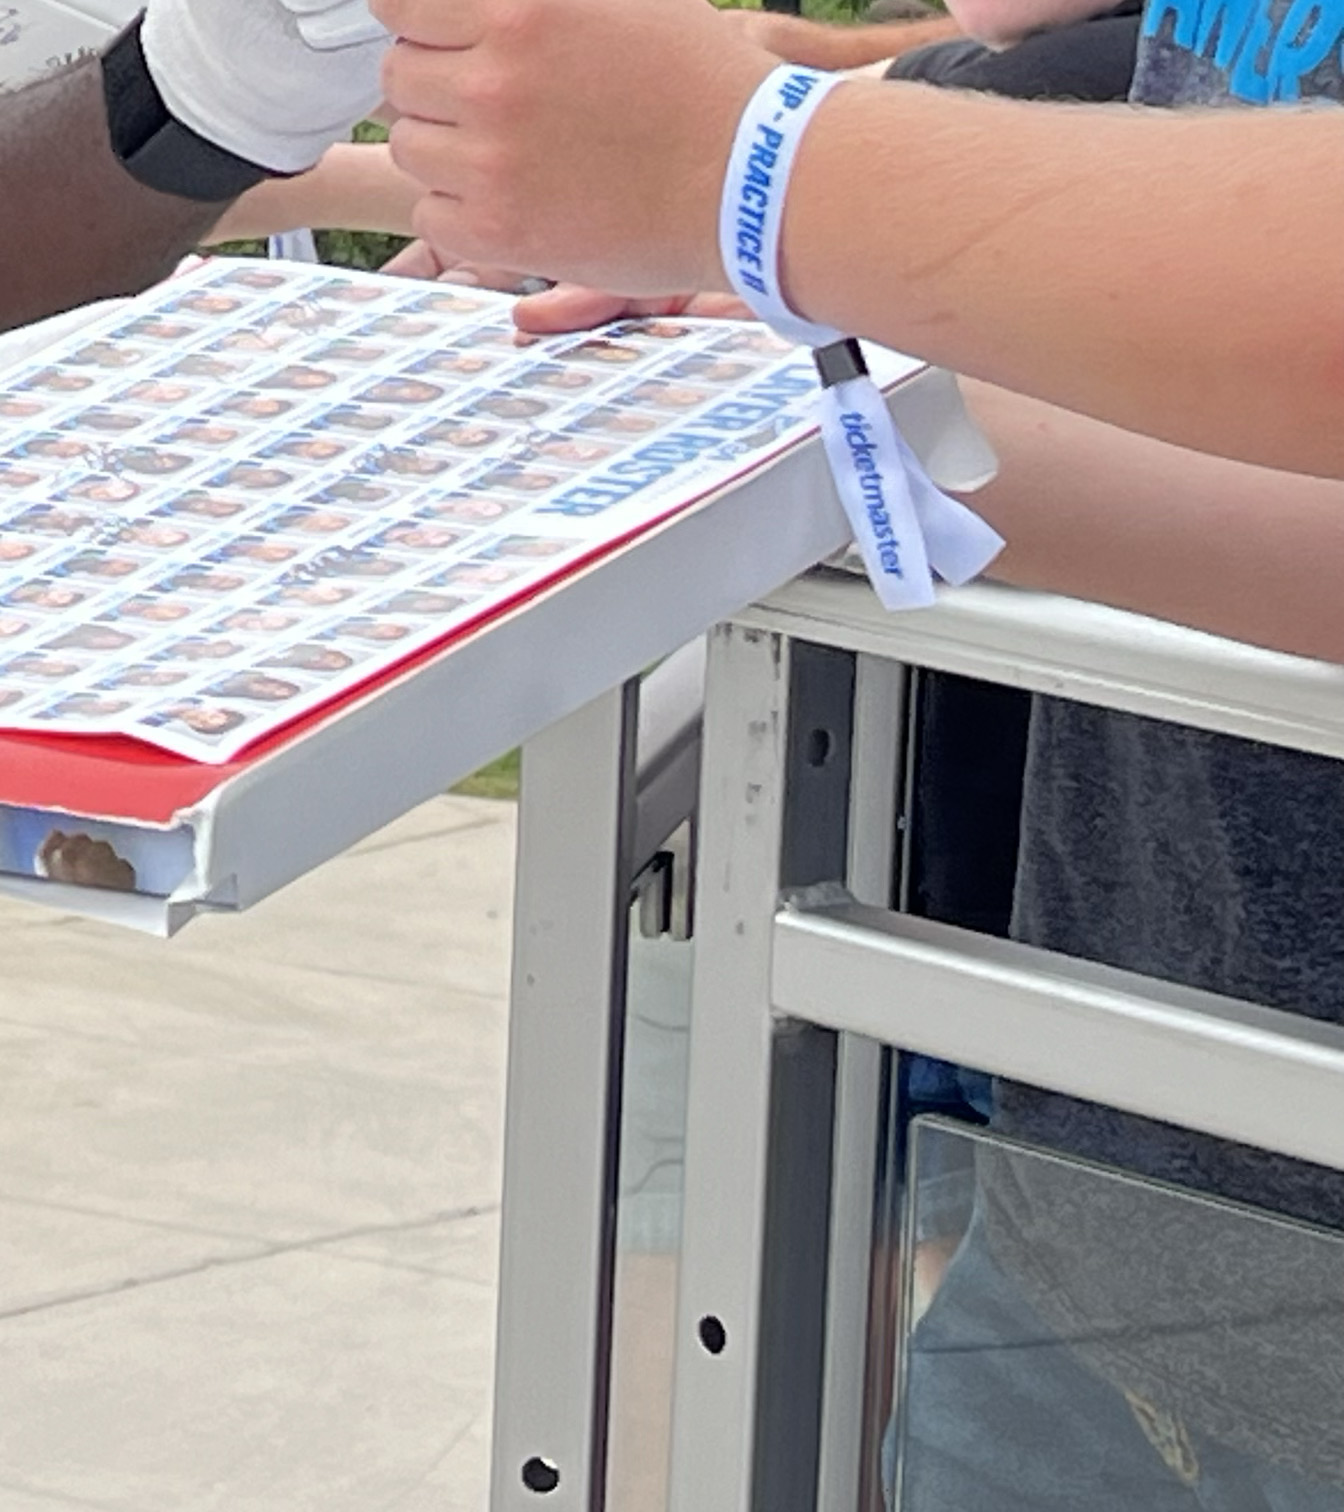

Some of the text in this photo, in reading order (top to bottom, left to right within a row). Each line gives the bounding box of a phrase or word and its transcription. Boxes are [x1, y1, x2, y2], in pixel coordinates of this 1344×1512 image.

[777, 73, 820, 110] VIP
[736, 123, 784, 272] PRACTICE
[682, 363, 818, 431] LAYER
[533, 432, 728, 517] ROSTER
[840, 411, 904, 580] ticketmaster
